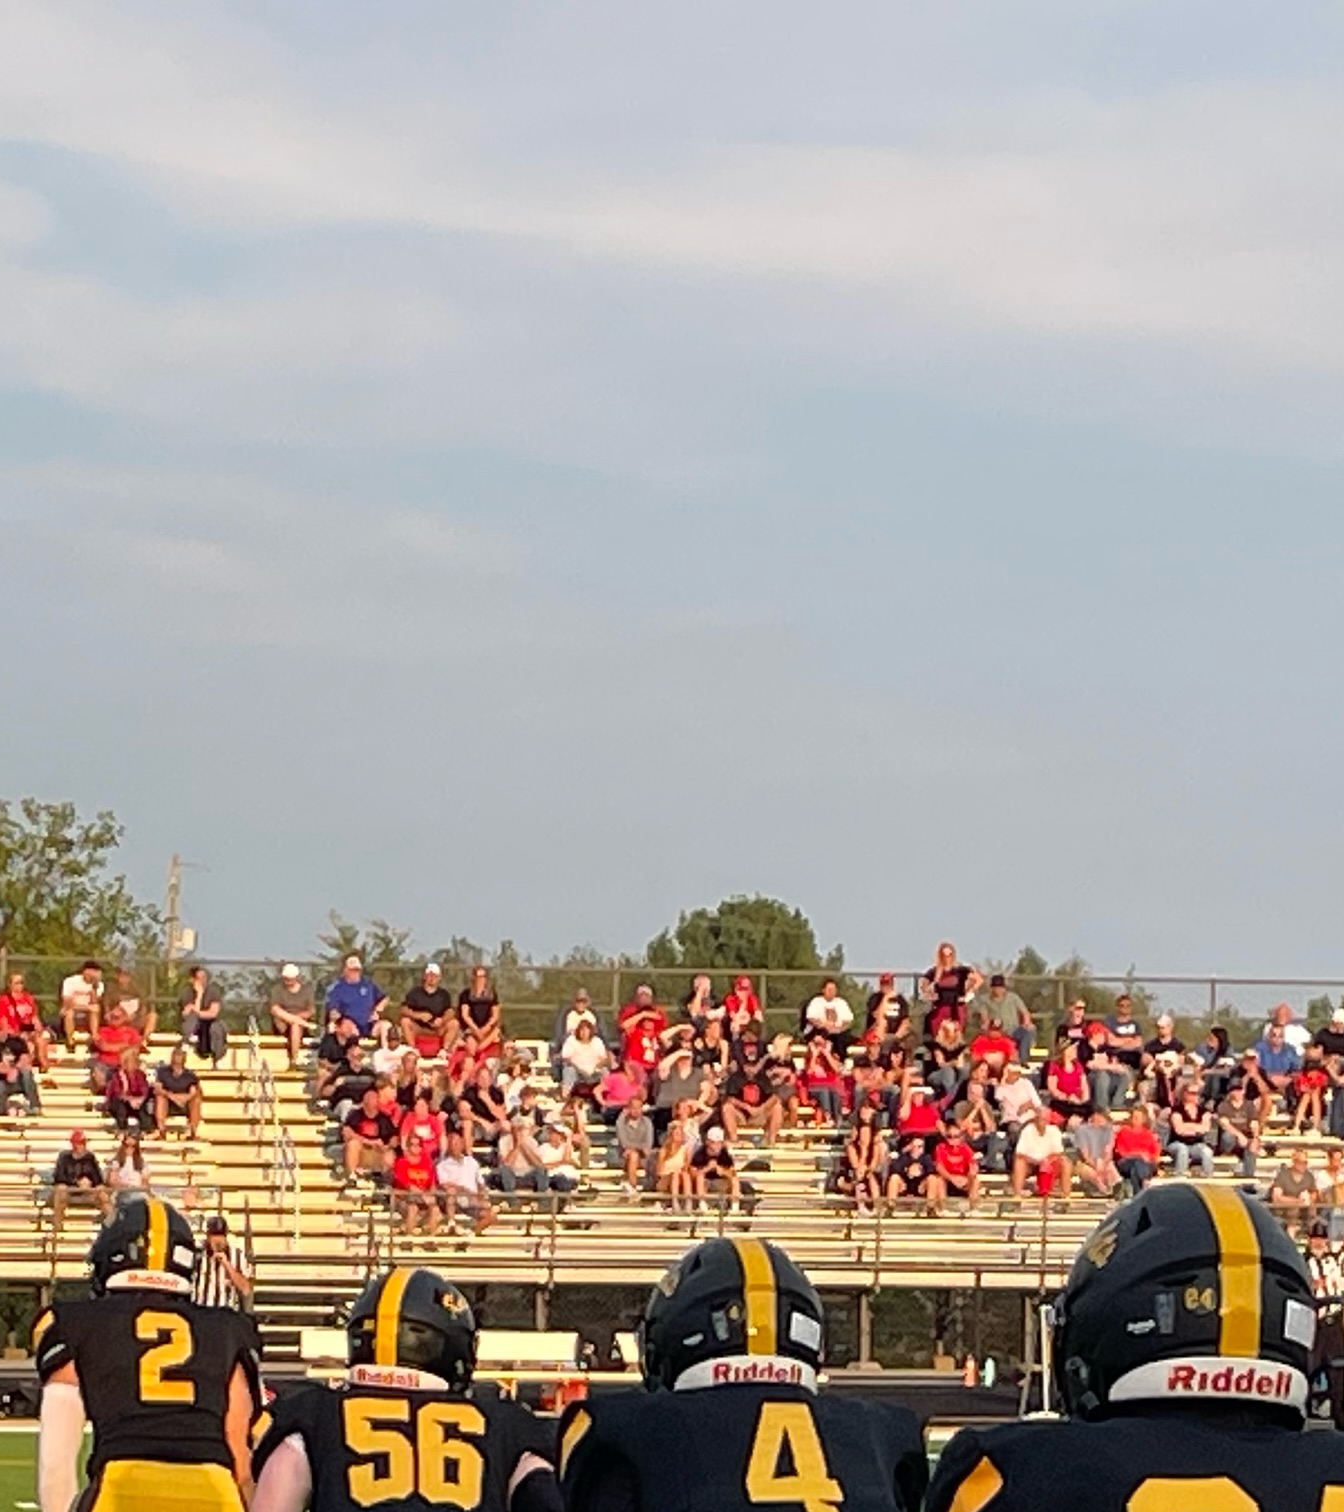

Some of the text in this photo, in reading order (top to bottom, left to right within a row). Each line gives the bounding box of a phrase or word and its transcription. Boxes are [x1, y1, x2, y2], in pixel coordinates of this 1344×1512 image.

[135, 1308, 195, 1403] 2
[712, 1362, 803, 1384] Riddell
[1167, 1364, 1292, 1399] Riddell
[343, 1397, 486, 1511] 56
